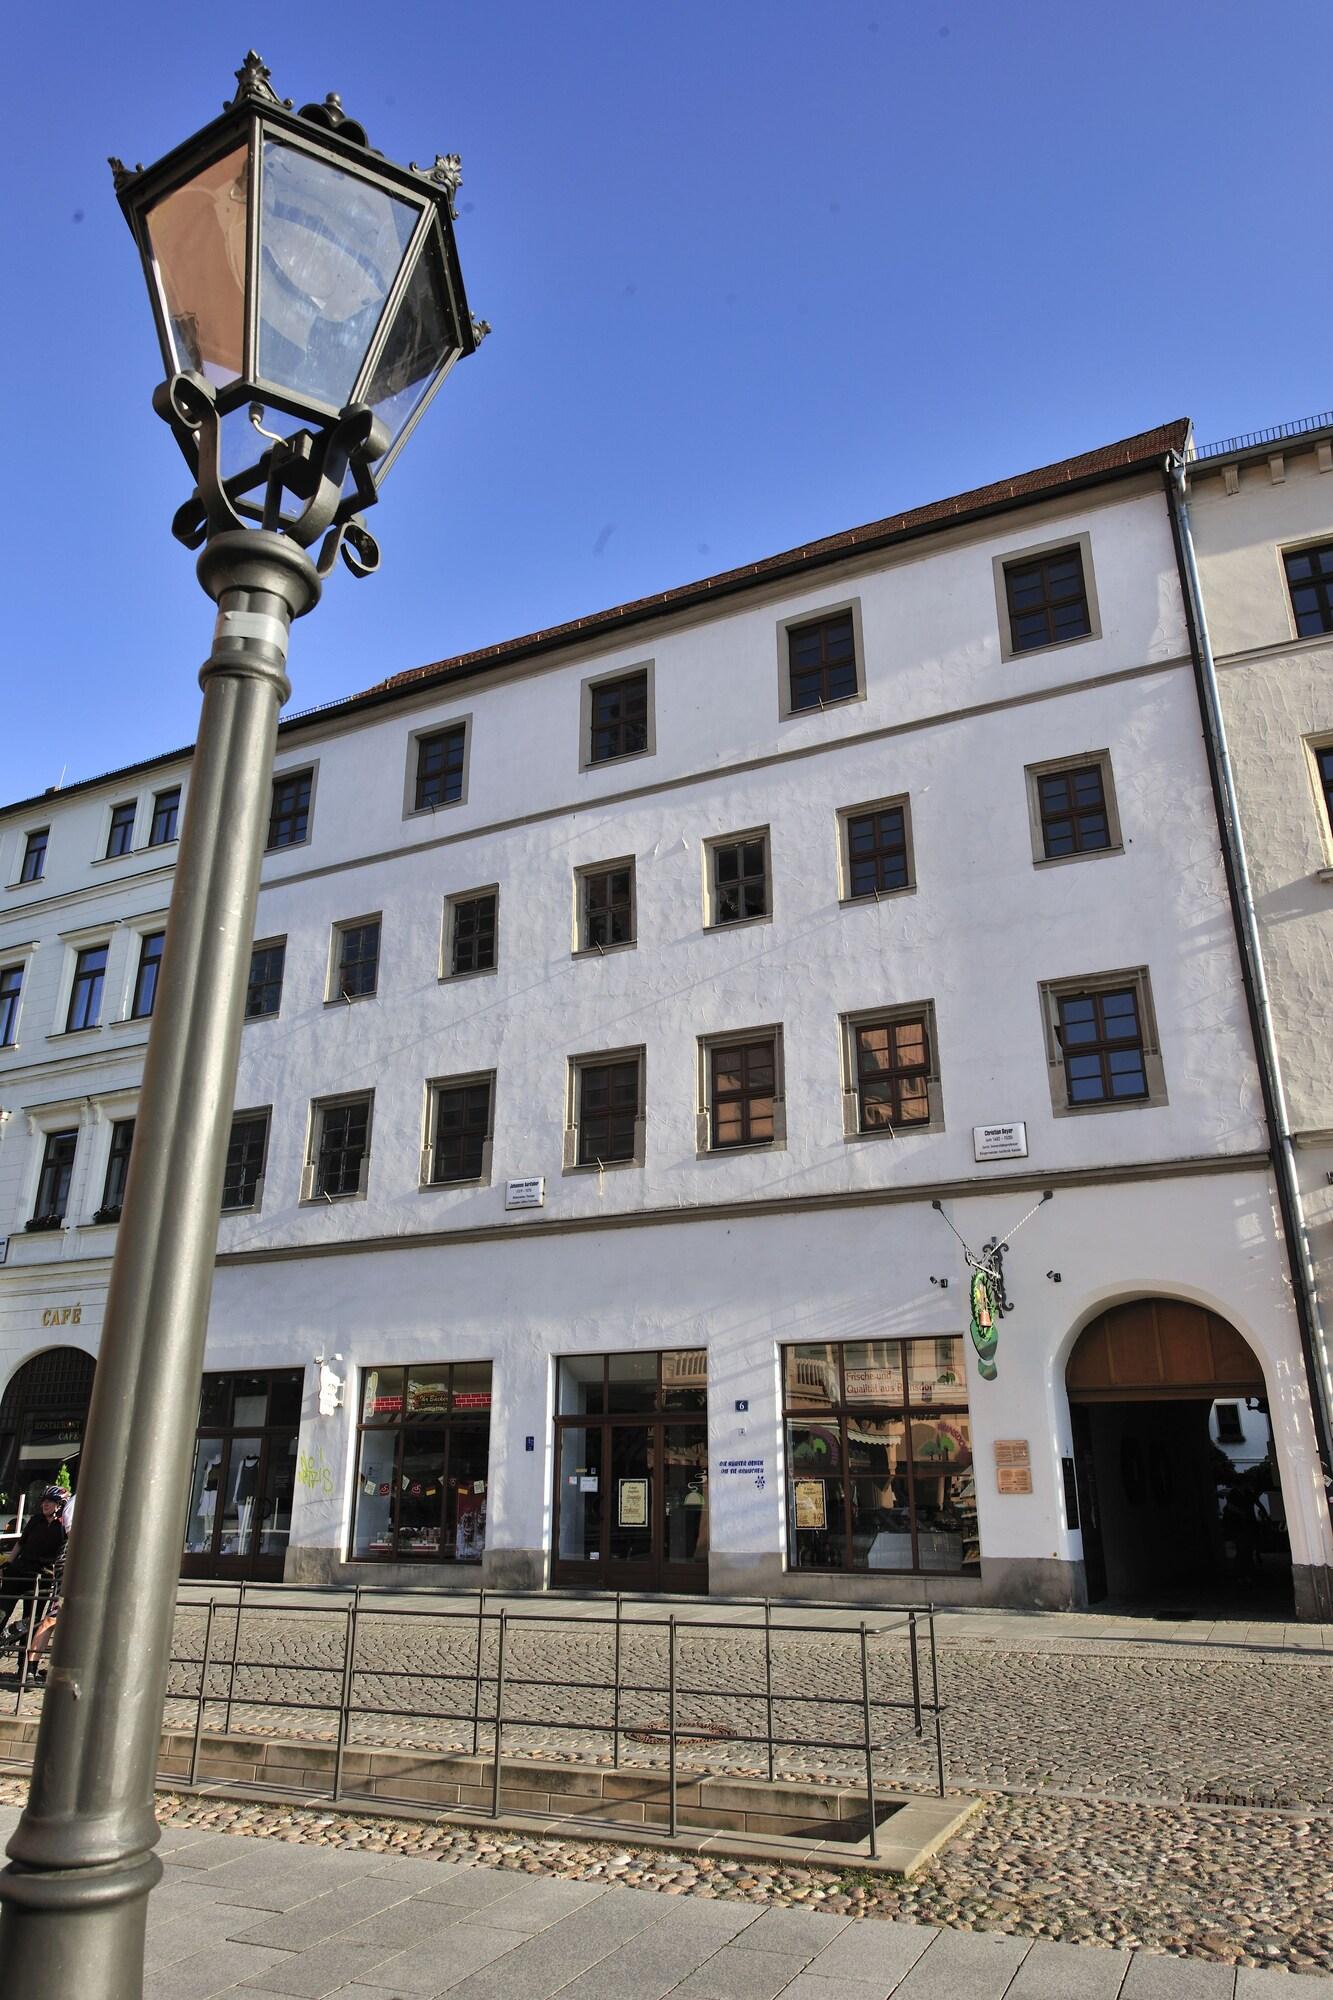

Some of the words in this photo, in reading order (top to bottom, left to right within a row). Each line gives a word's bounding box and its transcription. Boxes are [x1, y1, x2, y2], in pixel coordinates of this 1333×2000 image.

[43, 1302, 82, 1326] CAFÉ
[846, 1370, 873, 1381] Frische
[876, 1370, 891, 1380] und
[846, 1382, 877, 1394] Qualität
[881, 1384, 895, 1392] aus
[740, 1402, 745, 1410] 6
